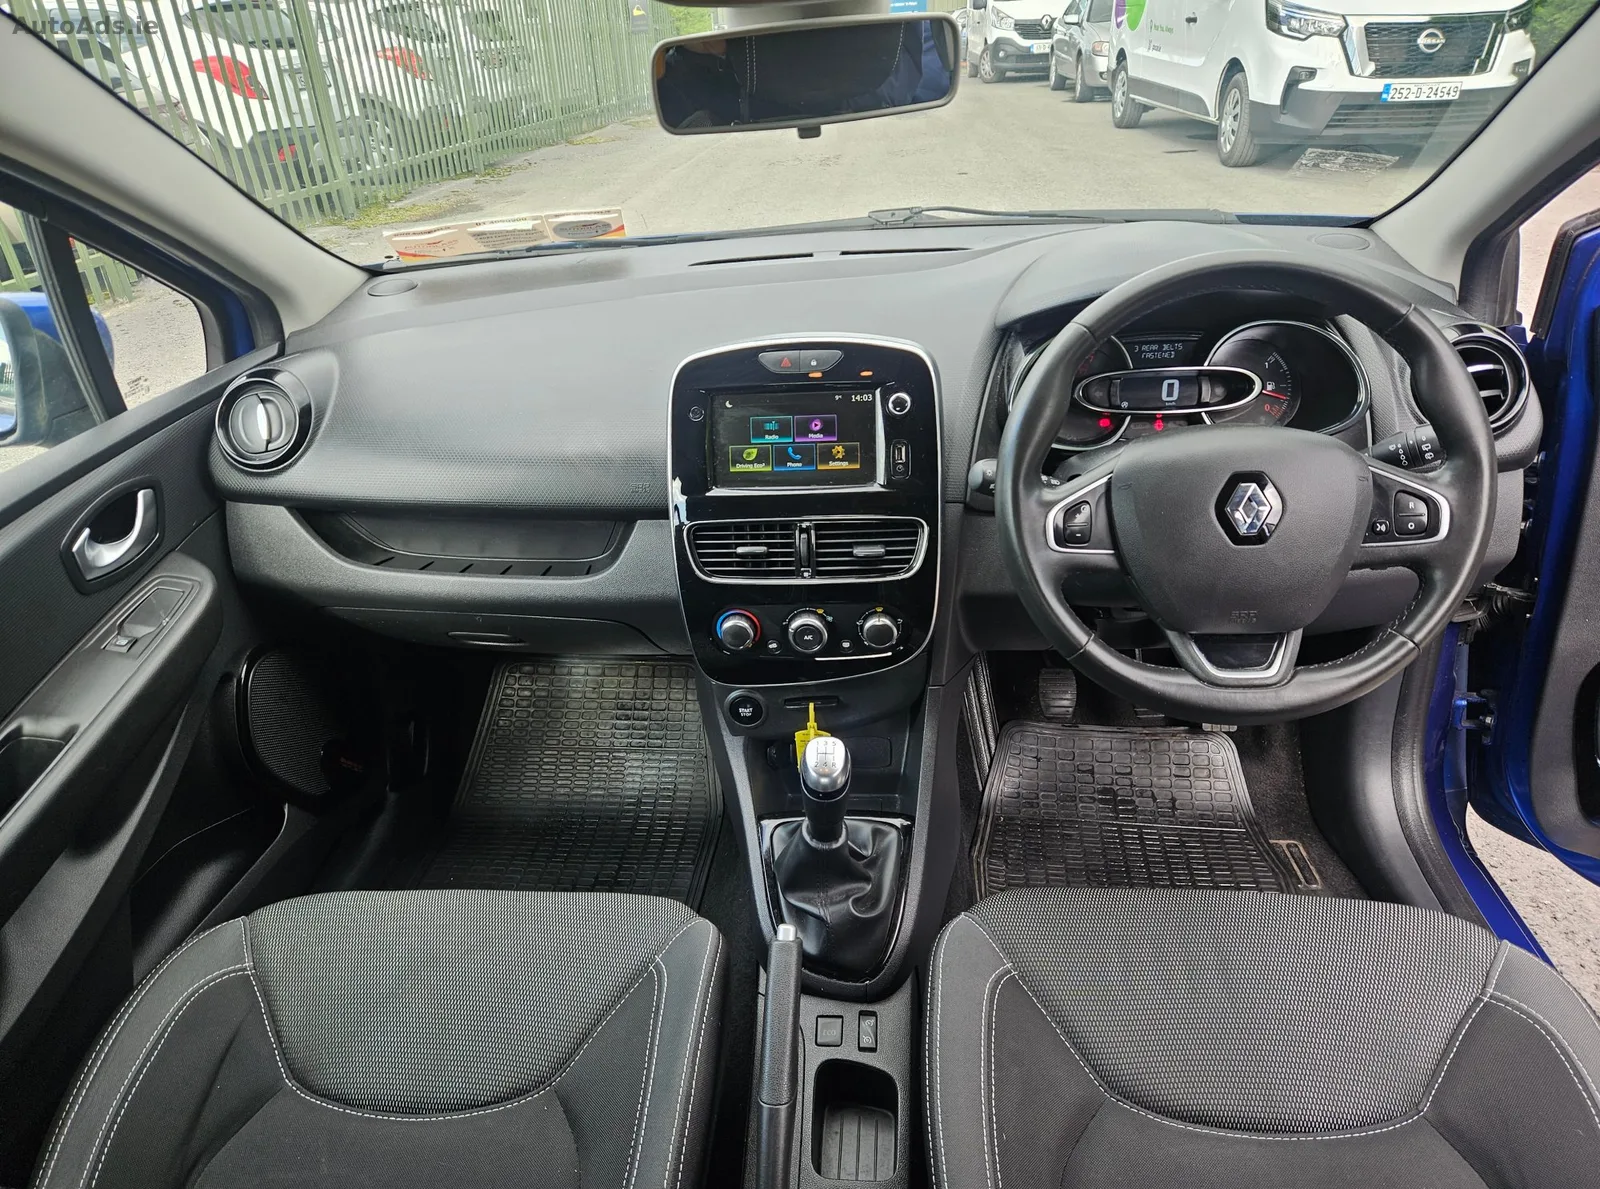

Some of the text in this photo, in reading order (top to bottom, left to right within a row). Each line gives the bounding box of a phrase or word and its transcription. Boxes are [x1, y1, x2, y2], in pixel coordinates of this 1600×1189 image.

[1390, 85, 1459, 100] 252-D-24549
[1141, 351, 1175, 359] FASTENED
[1162, 379, 1180, 401] 0
[851, 394, 873, 402] 14:03
